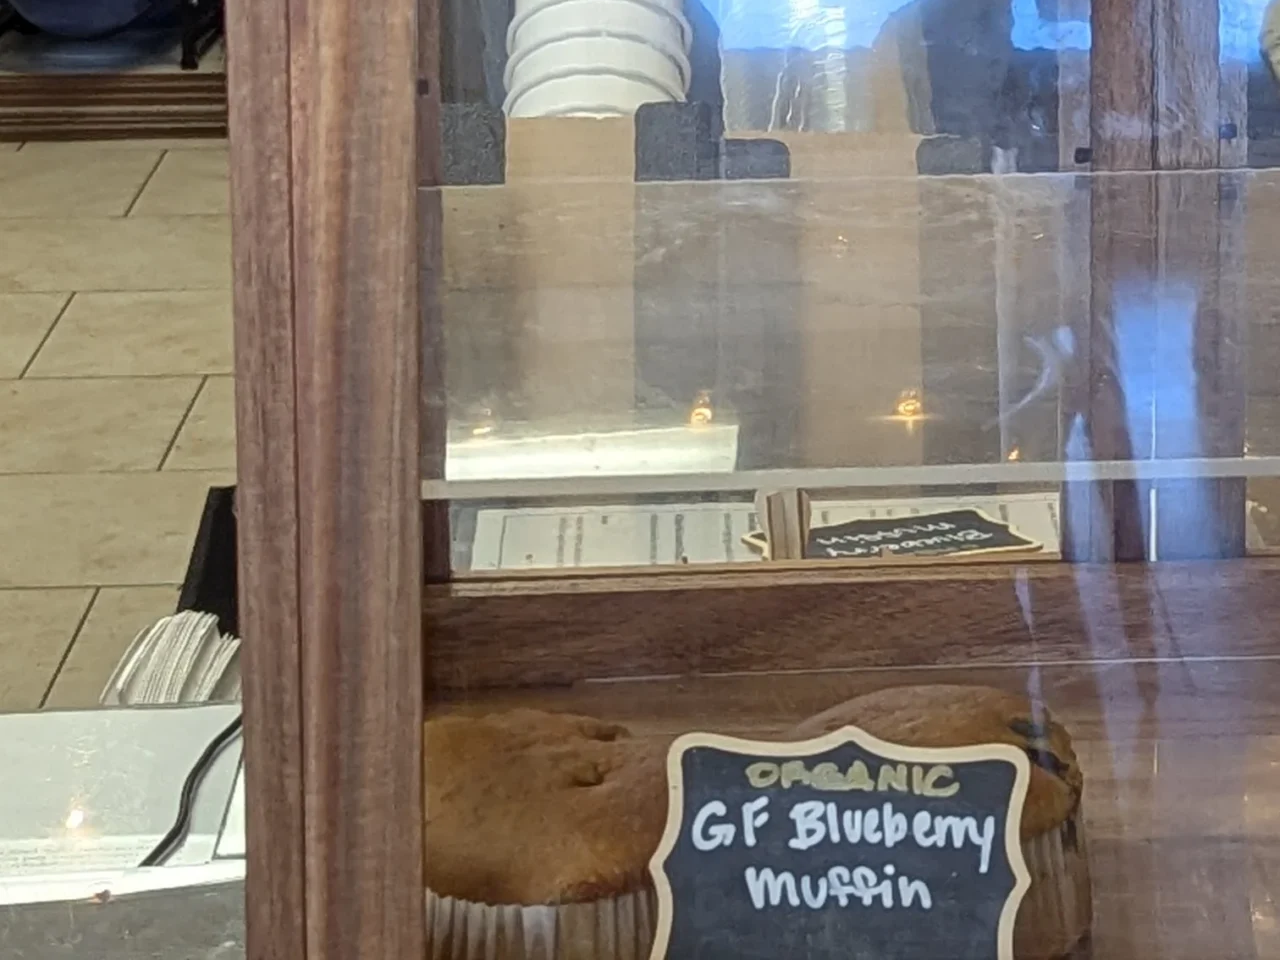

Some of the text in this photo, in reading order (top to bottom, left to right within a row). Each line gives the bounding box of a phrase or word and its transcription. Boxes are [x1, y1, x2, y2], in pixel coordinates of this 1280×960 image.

[744, 759, 961, 797] ORGANIC
[691, 796, 996, 874] GF Blueberry
